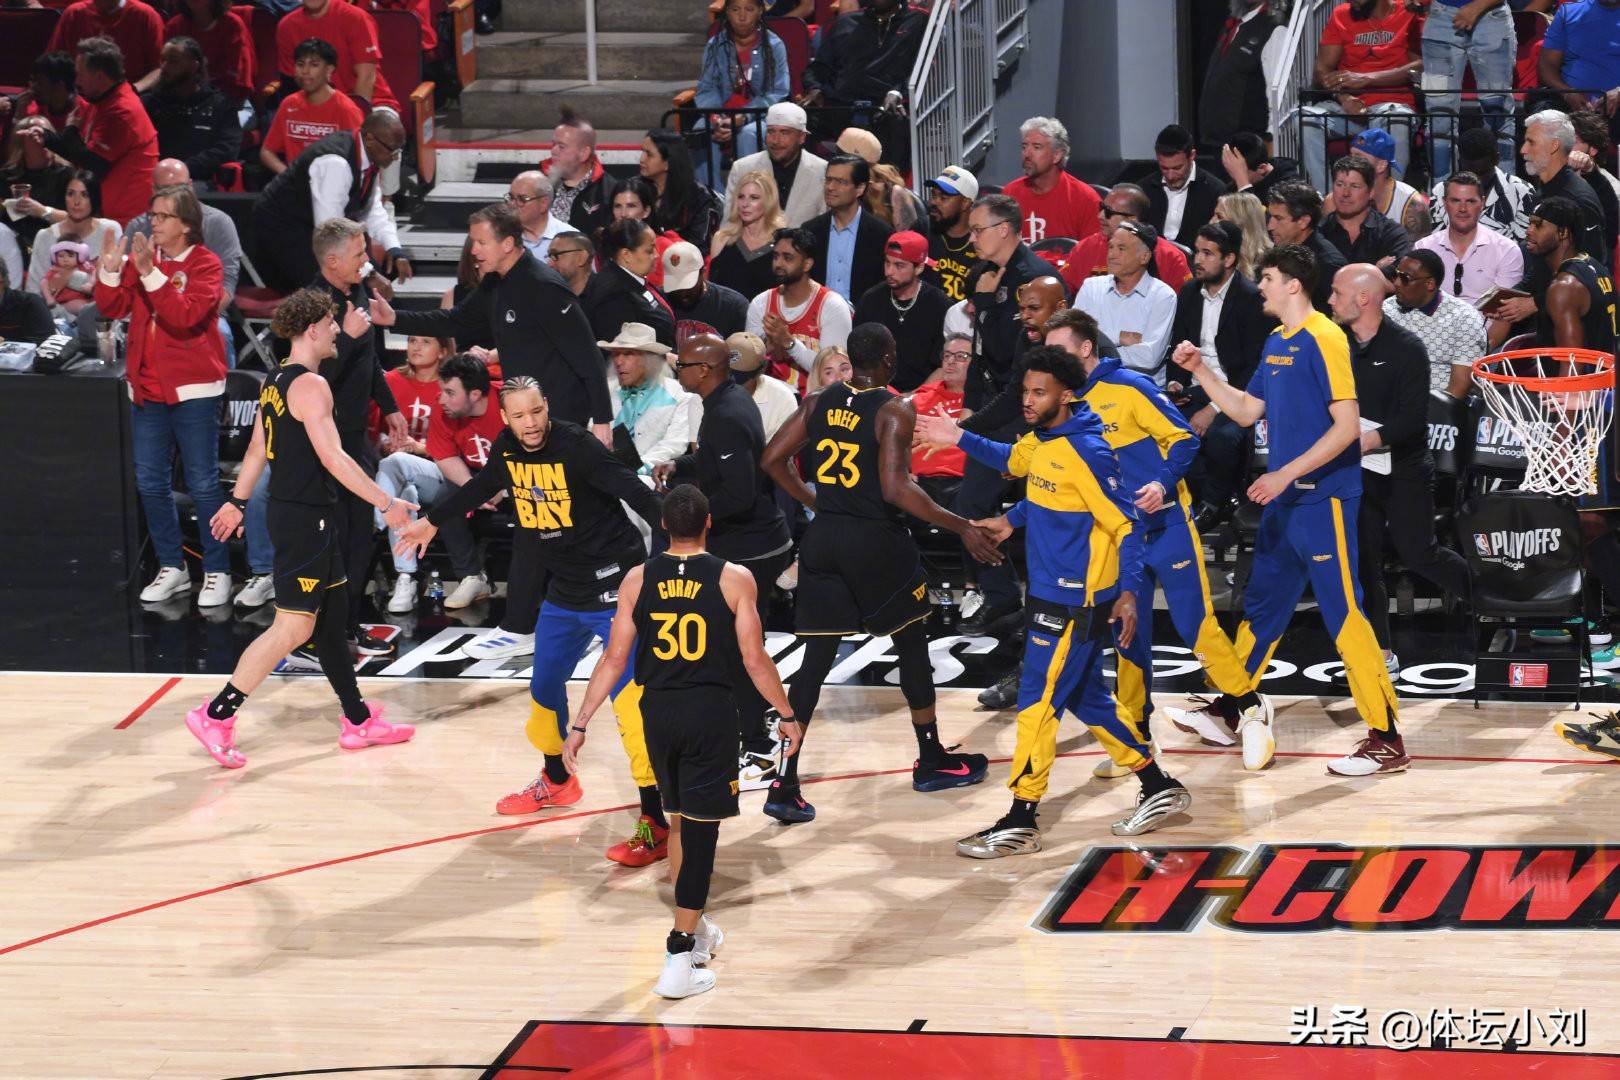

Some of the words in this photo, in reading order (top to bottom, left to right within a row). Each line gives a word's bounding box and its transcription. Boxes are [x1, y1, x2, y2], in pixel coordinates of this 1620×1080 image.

[827, 409, 861, 431] GREEN
[506, 460, 568, 490] WIN
[816, 438, 861, 489] 23
[546, 489, 571, 501] THE
[515, 500, 574, 530] BAY
[1490, 528, 1562, 559] PLAYOFFS
[1502, 557, 1525, 571] Google
[658, 579, 703, 600] CURRY
[650, 612, 707, 661] 30
